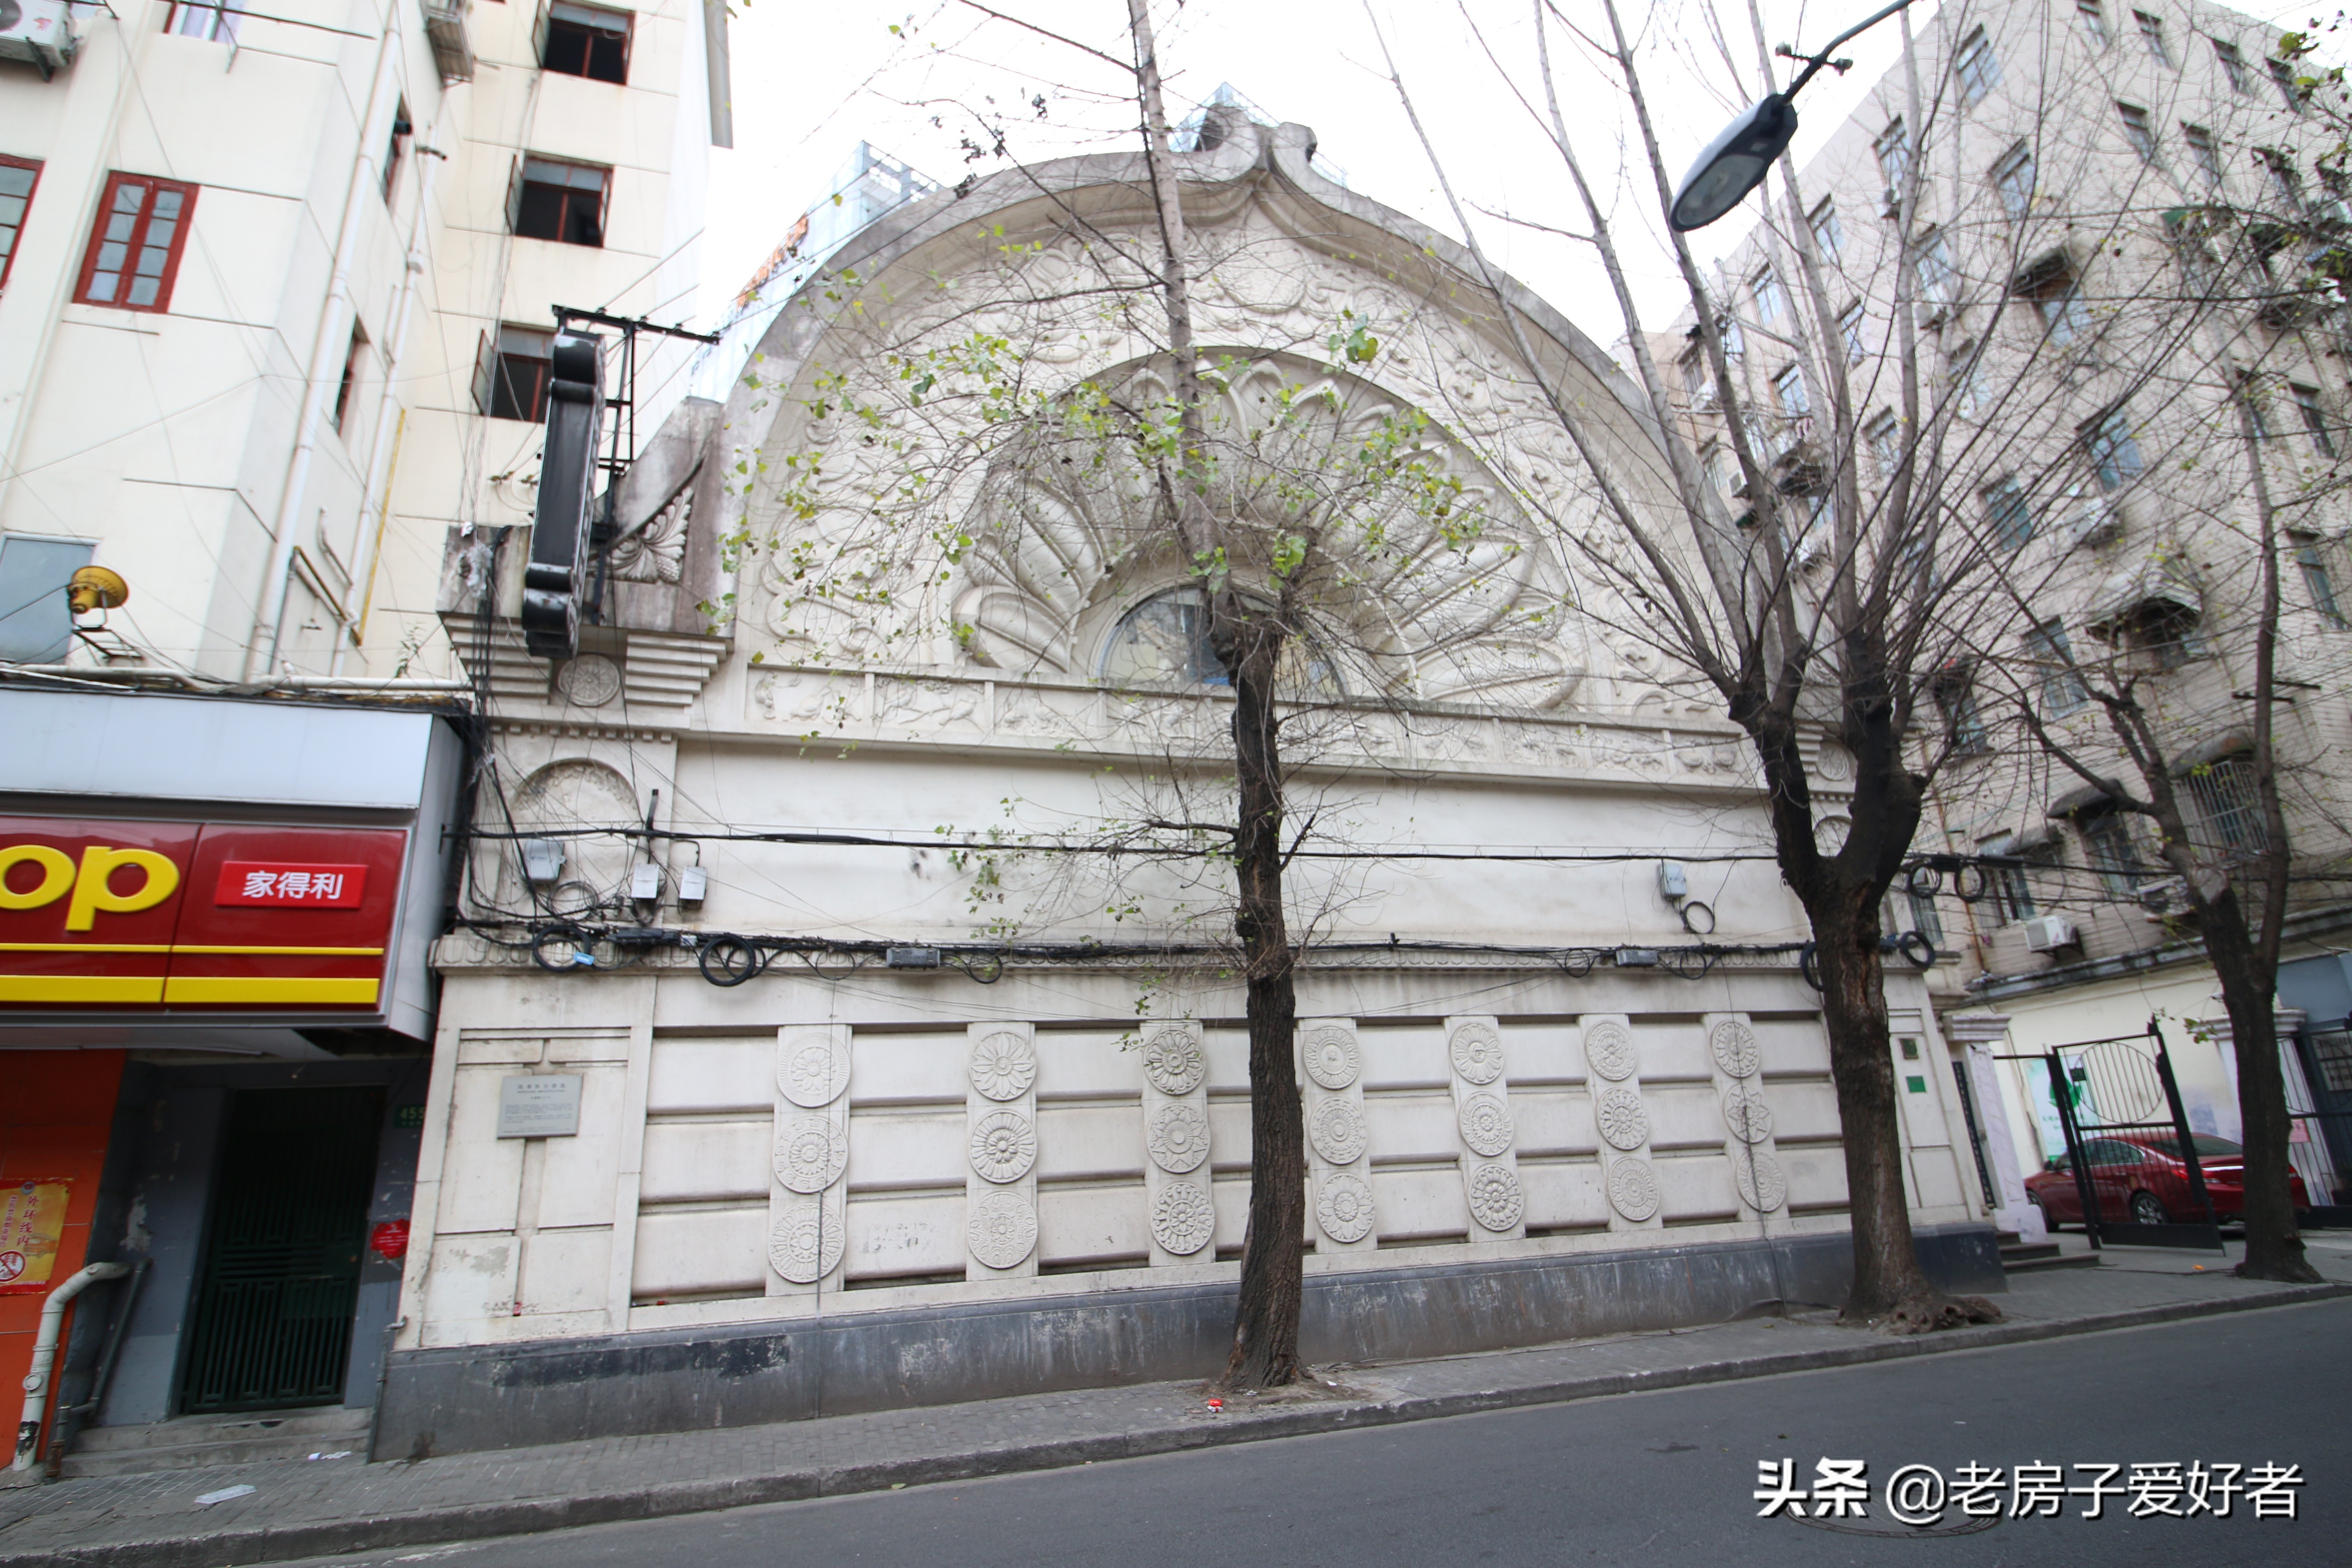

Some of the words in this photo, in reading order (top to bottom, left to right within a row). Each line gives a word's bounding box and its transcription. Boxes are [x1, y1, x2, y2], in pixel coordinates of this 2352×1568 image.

[242, 870, 344, 900] 家得利
[17, 1195, 40, 1246] 外环线内
